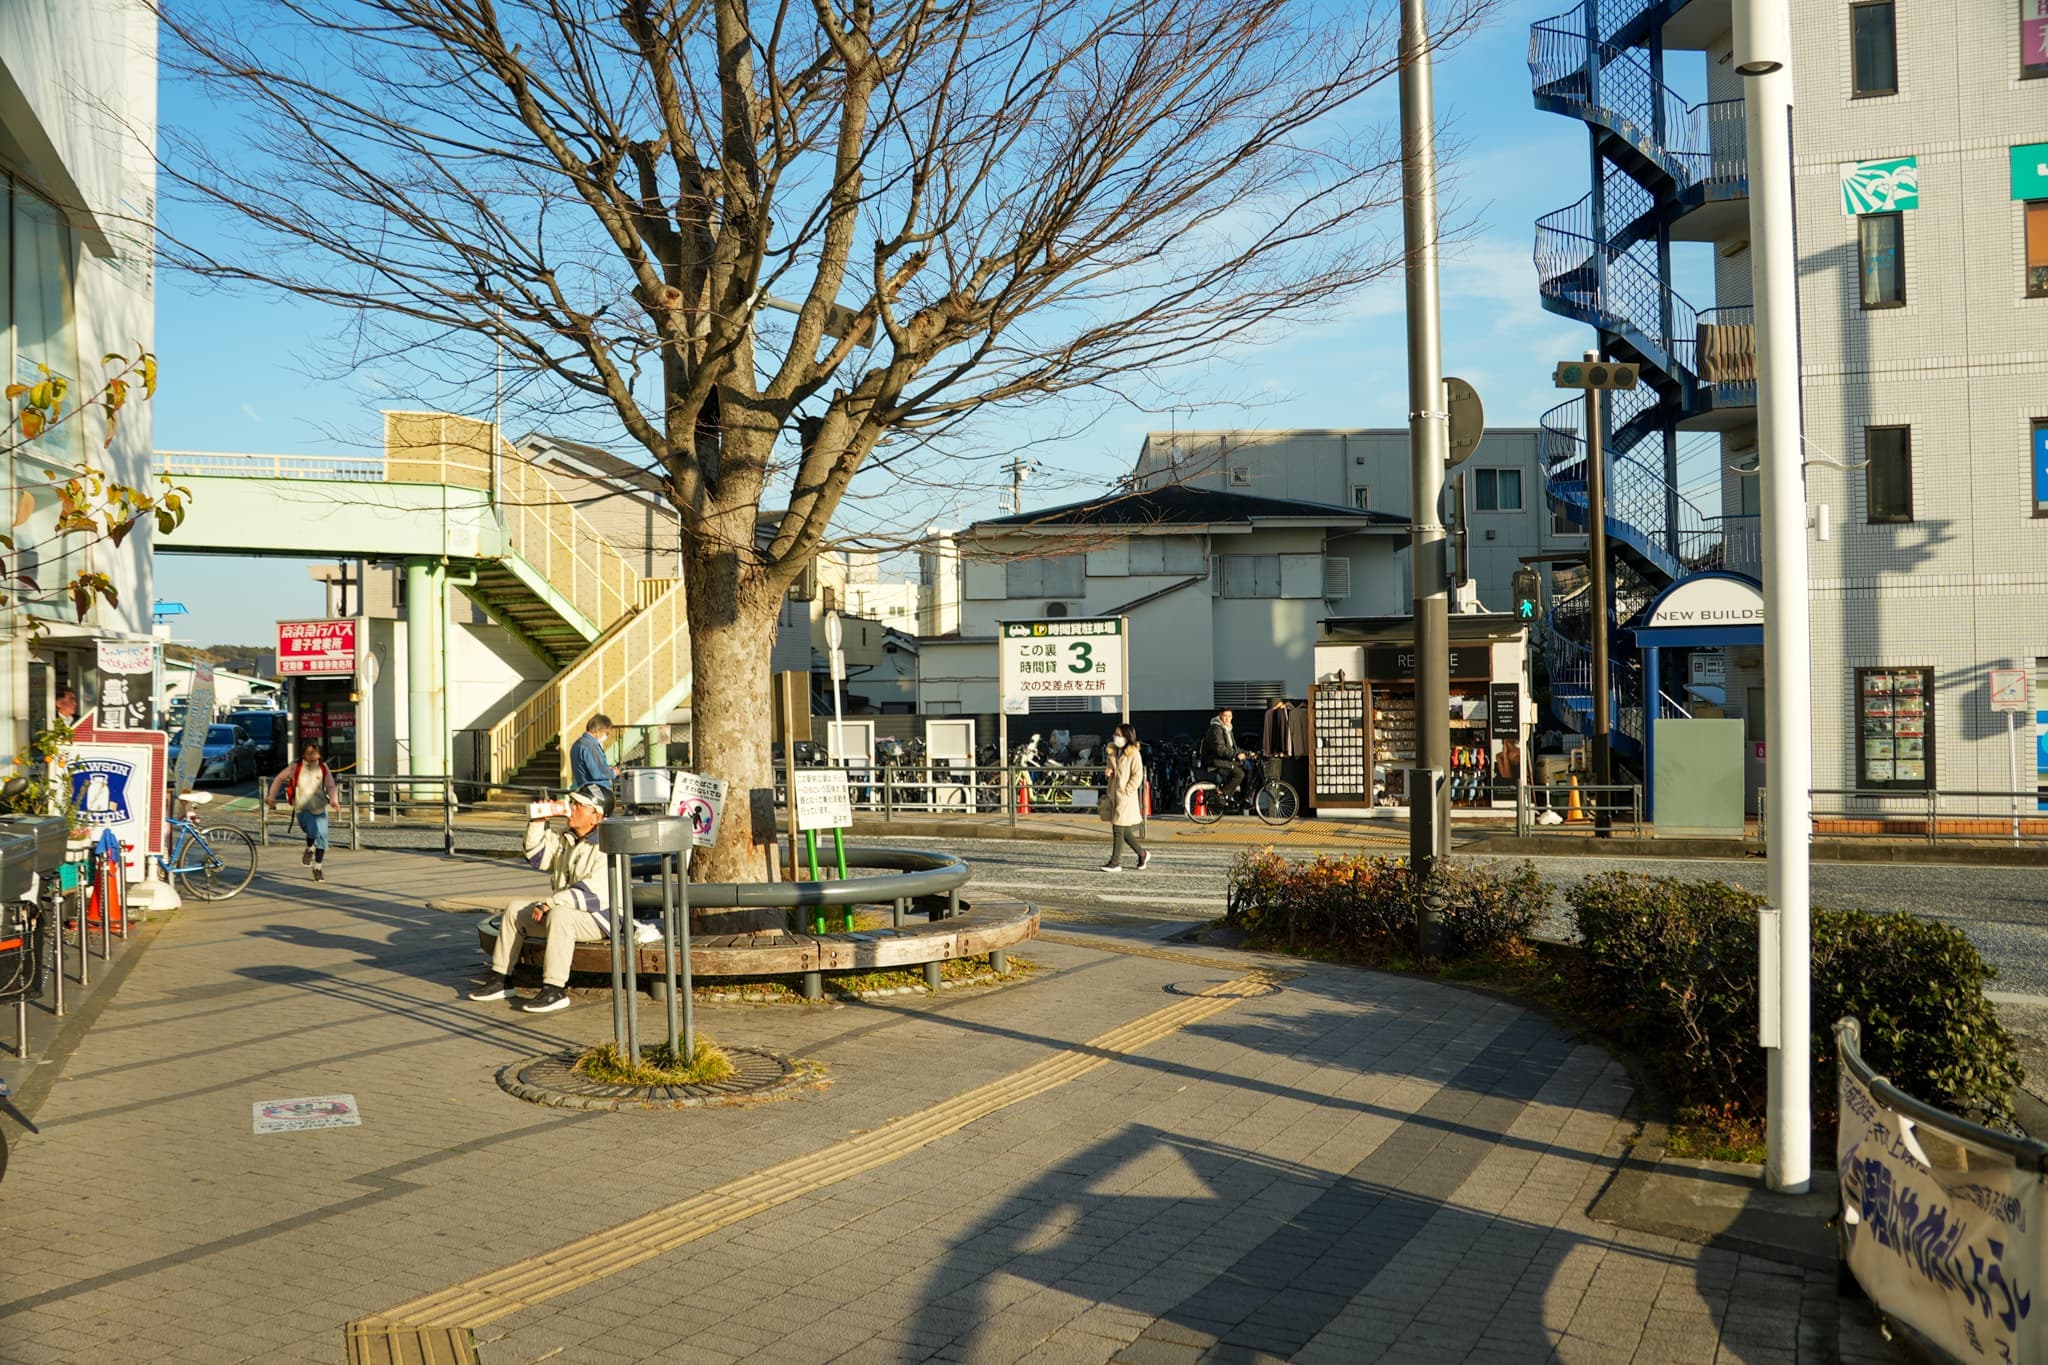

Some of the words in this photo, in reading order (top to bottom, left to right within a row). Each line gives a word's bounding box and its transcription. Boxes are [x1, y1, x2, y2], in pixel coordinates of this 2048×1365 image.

[1656, 610, 1693, 621] NEW
[1048, 621, 1116, 635] 時間貸駐車場
[1020, 644, 1057, 657] この裏
[1020, 660, 1057, 674] 時間貸
[1020, 679, 1106, 692] 次の交差点を左折
[70, 761, 130, 776] AWSON
[72, 810, 127, 822] TATION
